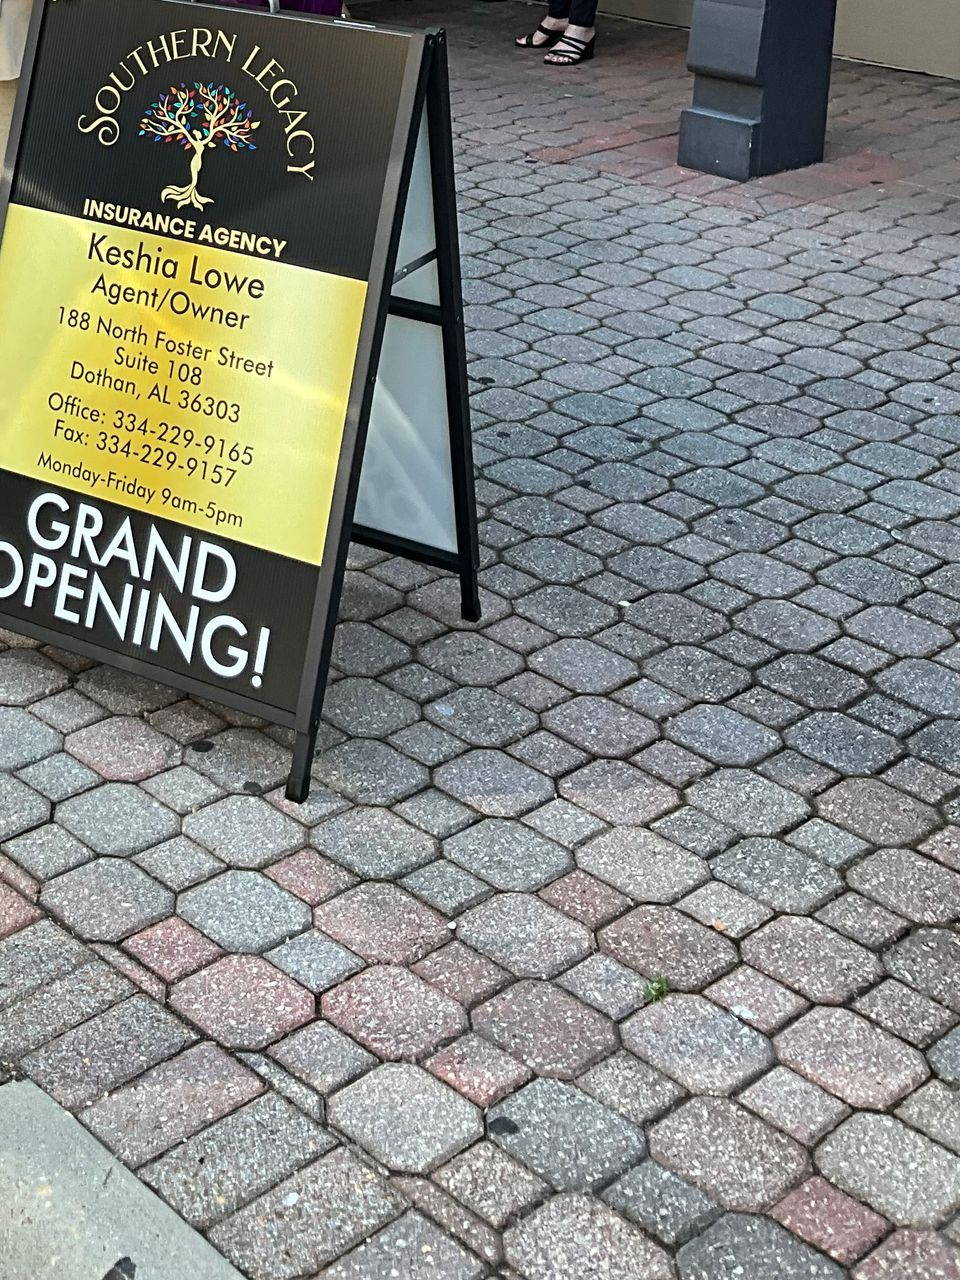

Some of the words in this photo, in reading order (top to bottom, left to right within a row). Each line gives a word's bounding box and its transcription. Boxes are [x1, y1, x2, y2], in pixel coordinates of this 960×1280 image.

[78, 28, 237, 146] SOUTHERN
[242, 46, 317, 180] LEGACY
[84, 199, 195, 238] INSURANCE
[198, 229, 286, 257] AGENCY
[88, 233, 178, 280] Keshia
[190, 256, 265, 299] Lowe
[92, 274, 249, 329] Agent/Owner
[59, 307, 90, 330] 188
[97, 316, 147, 346] North
[156, 333, 212, 362] Foster
[218, 348, 274, 378] Street
[115, 348, 159, 375] Suite
[169, 361, 202, 386] 108
[72, 362, 140, 400] Dothan,
[148, 386, 171, 404] AL
[179, 392, 240, 423] 36303
[49, 393, 106, 425] Office:
[114, 411, 254, 466] 334-229-9165
[55, 421, 89, 446] Fax:
[97, 432, 237, 487] 334-229-9157
[38, 452, 156, 503] Monday-Friday
[162, 489, 243, 527] 9am-5pm
[28, 493, 237, 602] GRAND
